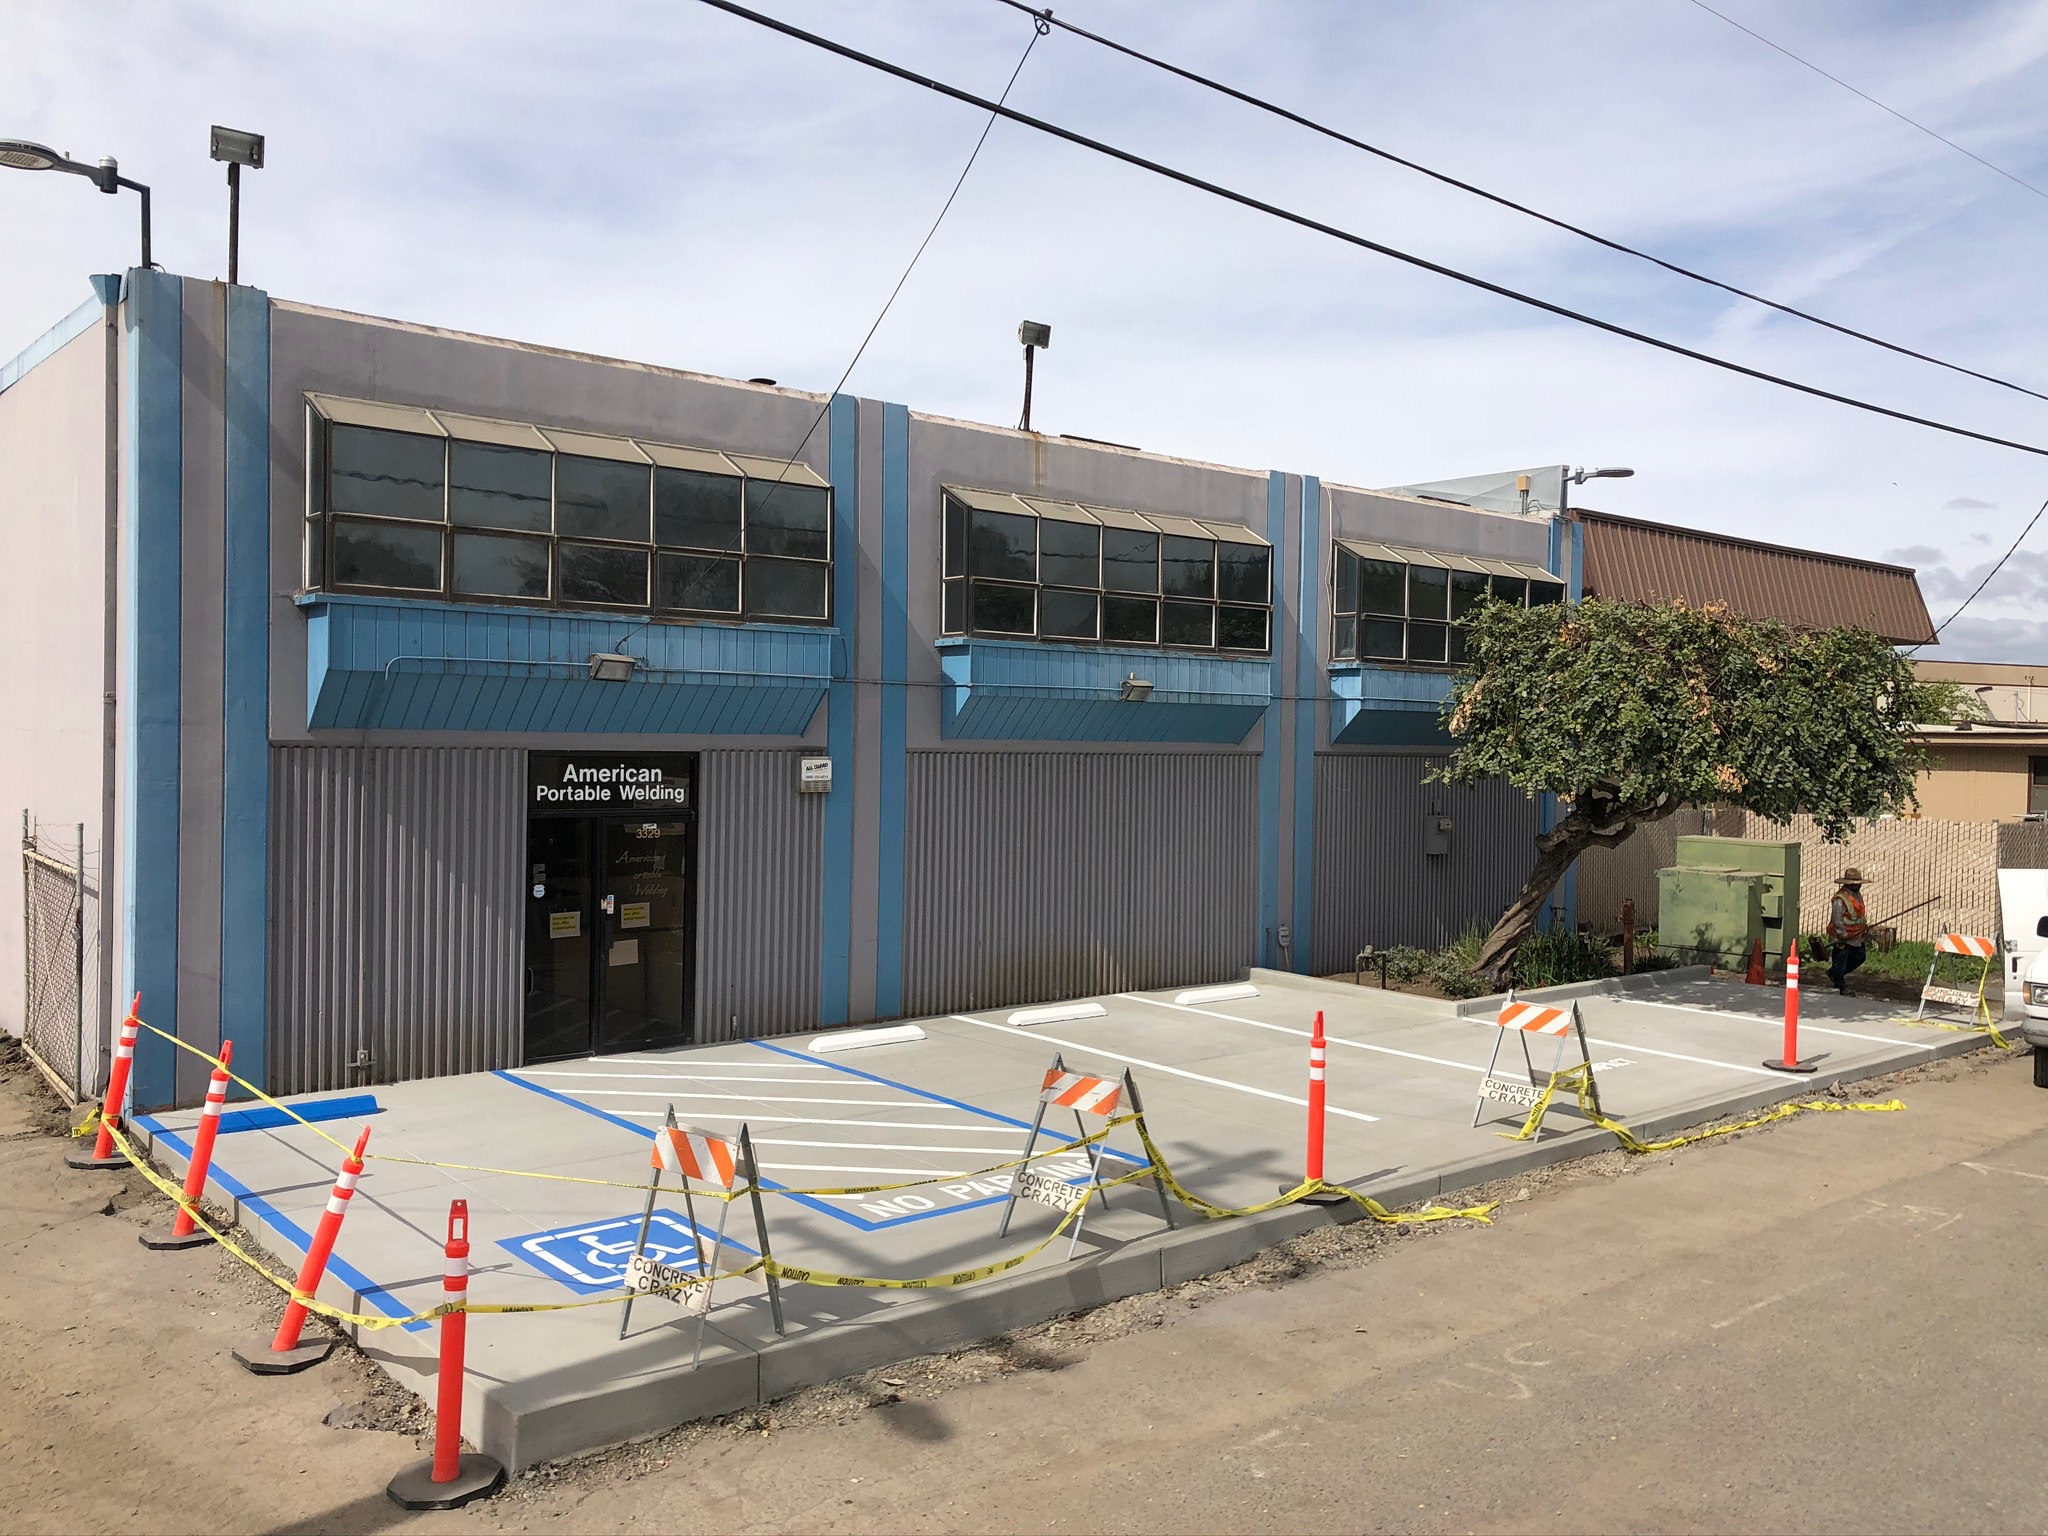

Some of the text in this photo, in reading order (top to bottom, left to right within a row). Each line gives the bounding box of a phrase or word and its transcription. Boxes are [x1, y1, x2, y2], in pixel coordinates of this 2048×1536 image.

[563, 763, 662, 783] American
[536, 784, 685, 803] Portable Welding
[636, 828, 661, 839] 3329
[635, 883, 669, 897] Welding
[1485, 1079, 1545, 1099] CONCRETE
[1489, 1090, 1536, 1107] CRAZY
[1018, 1172, 1084, 1200] CONCRETE
[858, 1194, 936, 1218] NO
[1021, 1186, 1072, 1211] CRAZY
[780, 1267, 810, 1282] CAUTION
[638, 1275, 694, 1306] CRAZY
